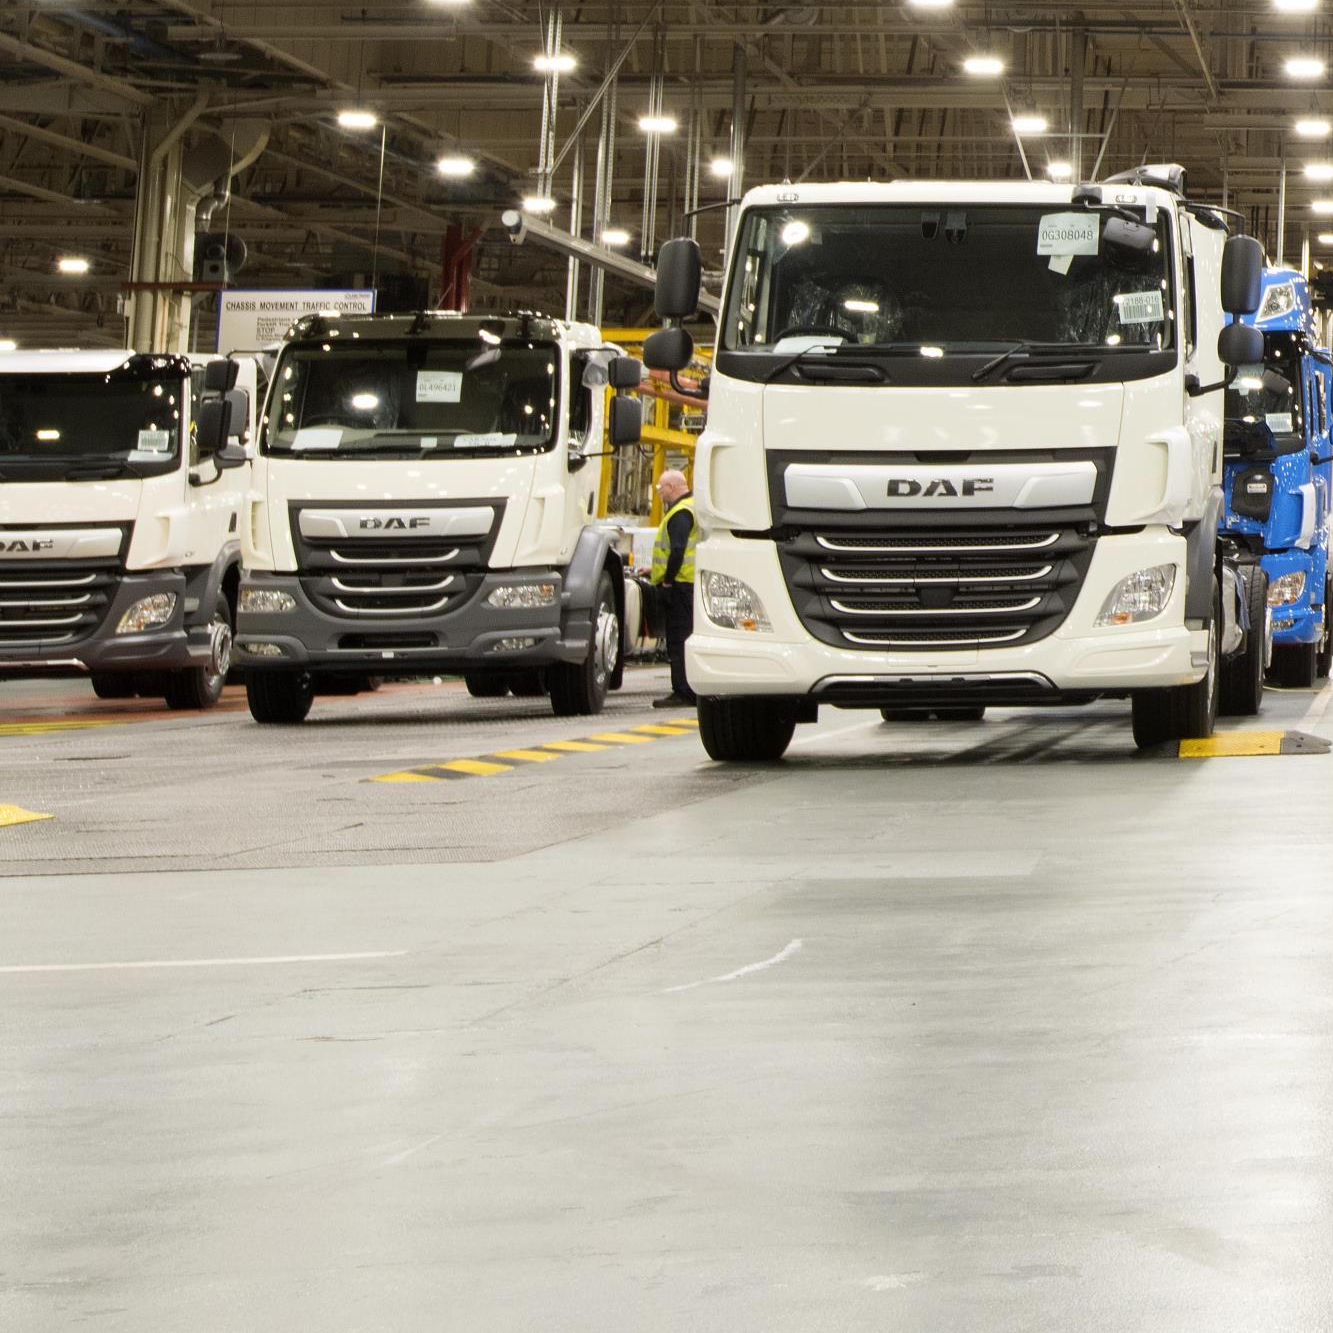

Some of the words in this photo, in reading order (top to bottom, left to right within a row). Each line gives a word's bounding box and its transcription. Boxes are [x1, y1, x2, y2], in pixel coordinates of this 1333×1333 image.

[226, 301, 256, 311] CHASSIS
[259, 301, 298, 311] MOVEMENT
[302, 301, 330, 311] TRAFFIC
[333, 301, 367, 311] CONTROL
[886, 478, 994, 497] DAF
[359, 517, 431, 529] DAF
[0, 539, 54, 552] AF
